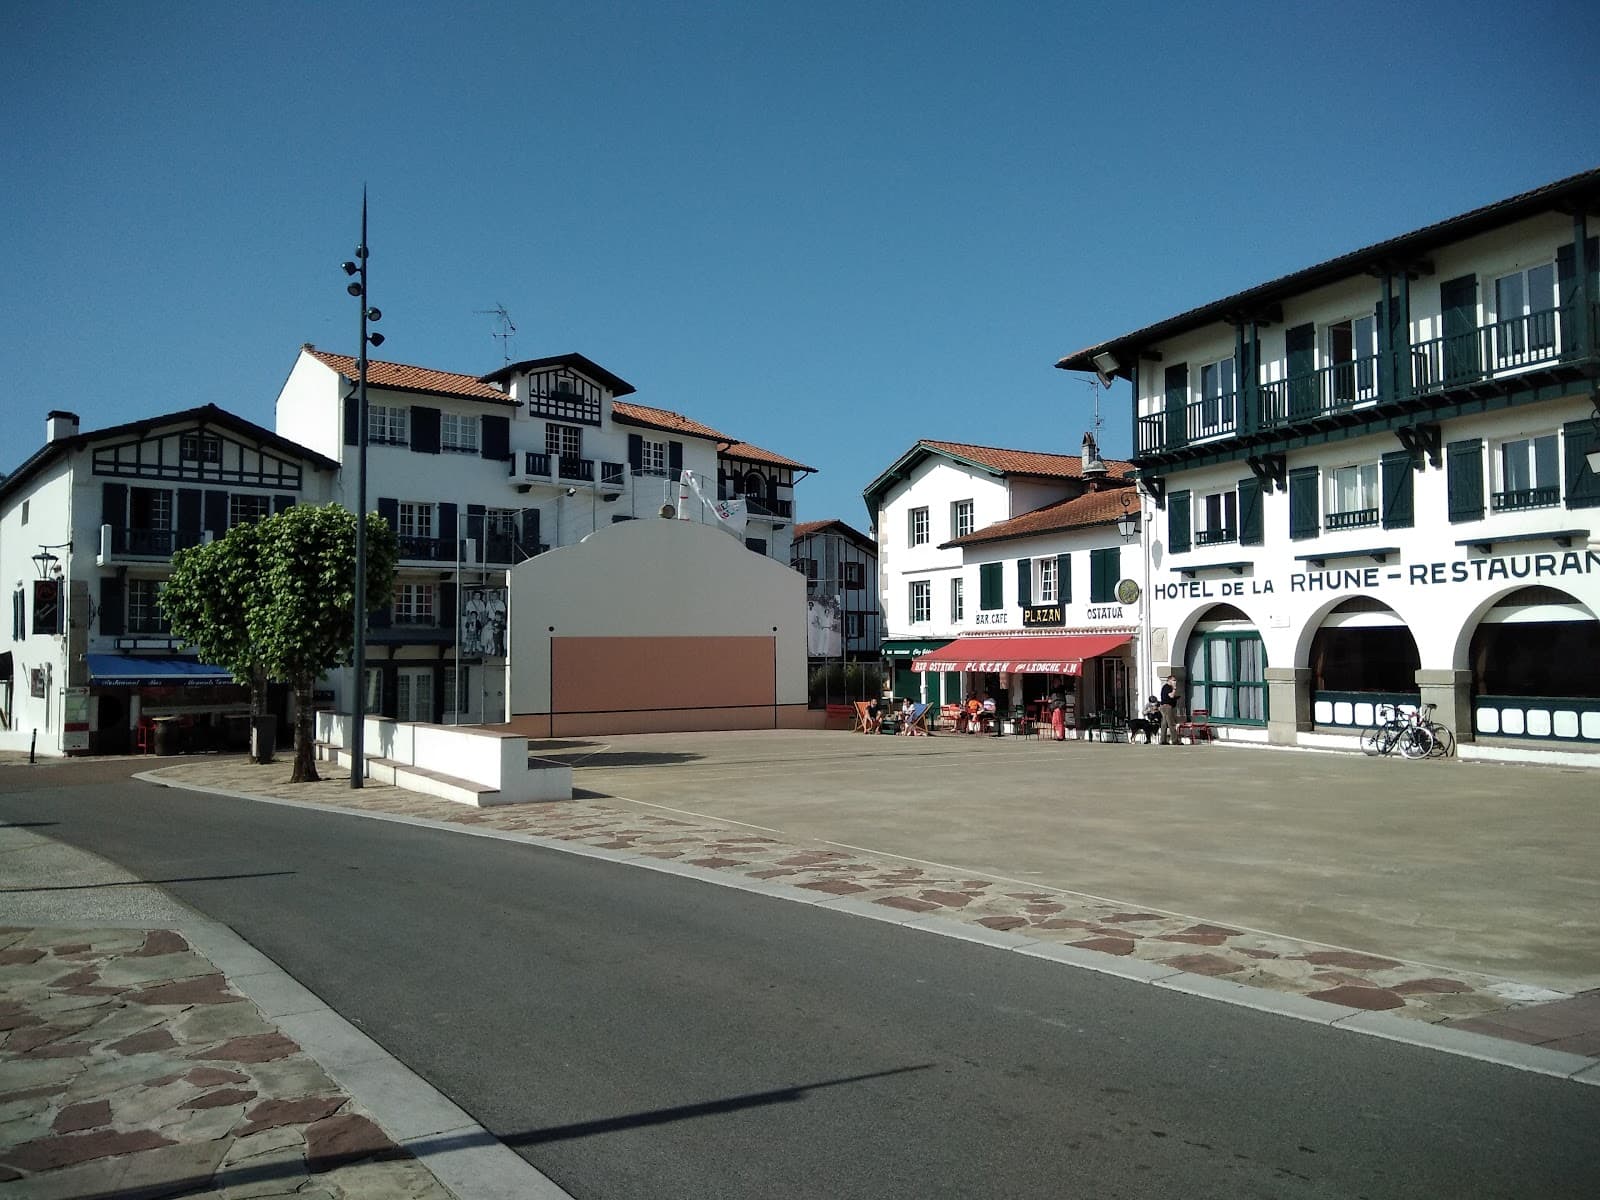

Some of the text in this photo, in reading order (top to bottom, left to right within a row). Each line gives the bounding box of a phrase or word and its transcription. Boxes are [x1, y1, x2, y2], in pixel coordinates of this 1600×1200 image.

[1154, 580, 1214, 600] HOTEL
[1221, 582, 1245, 596] DE
[1252, 579, 1275, 595] LA
[1290, 567, 1380, 592] RHUNE
[1024, 607, 1061, 622] PLAZAN
[1086, 606, 1124, 620] OSTATUA
